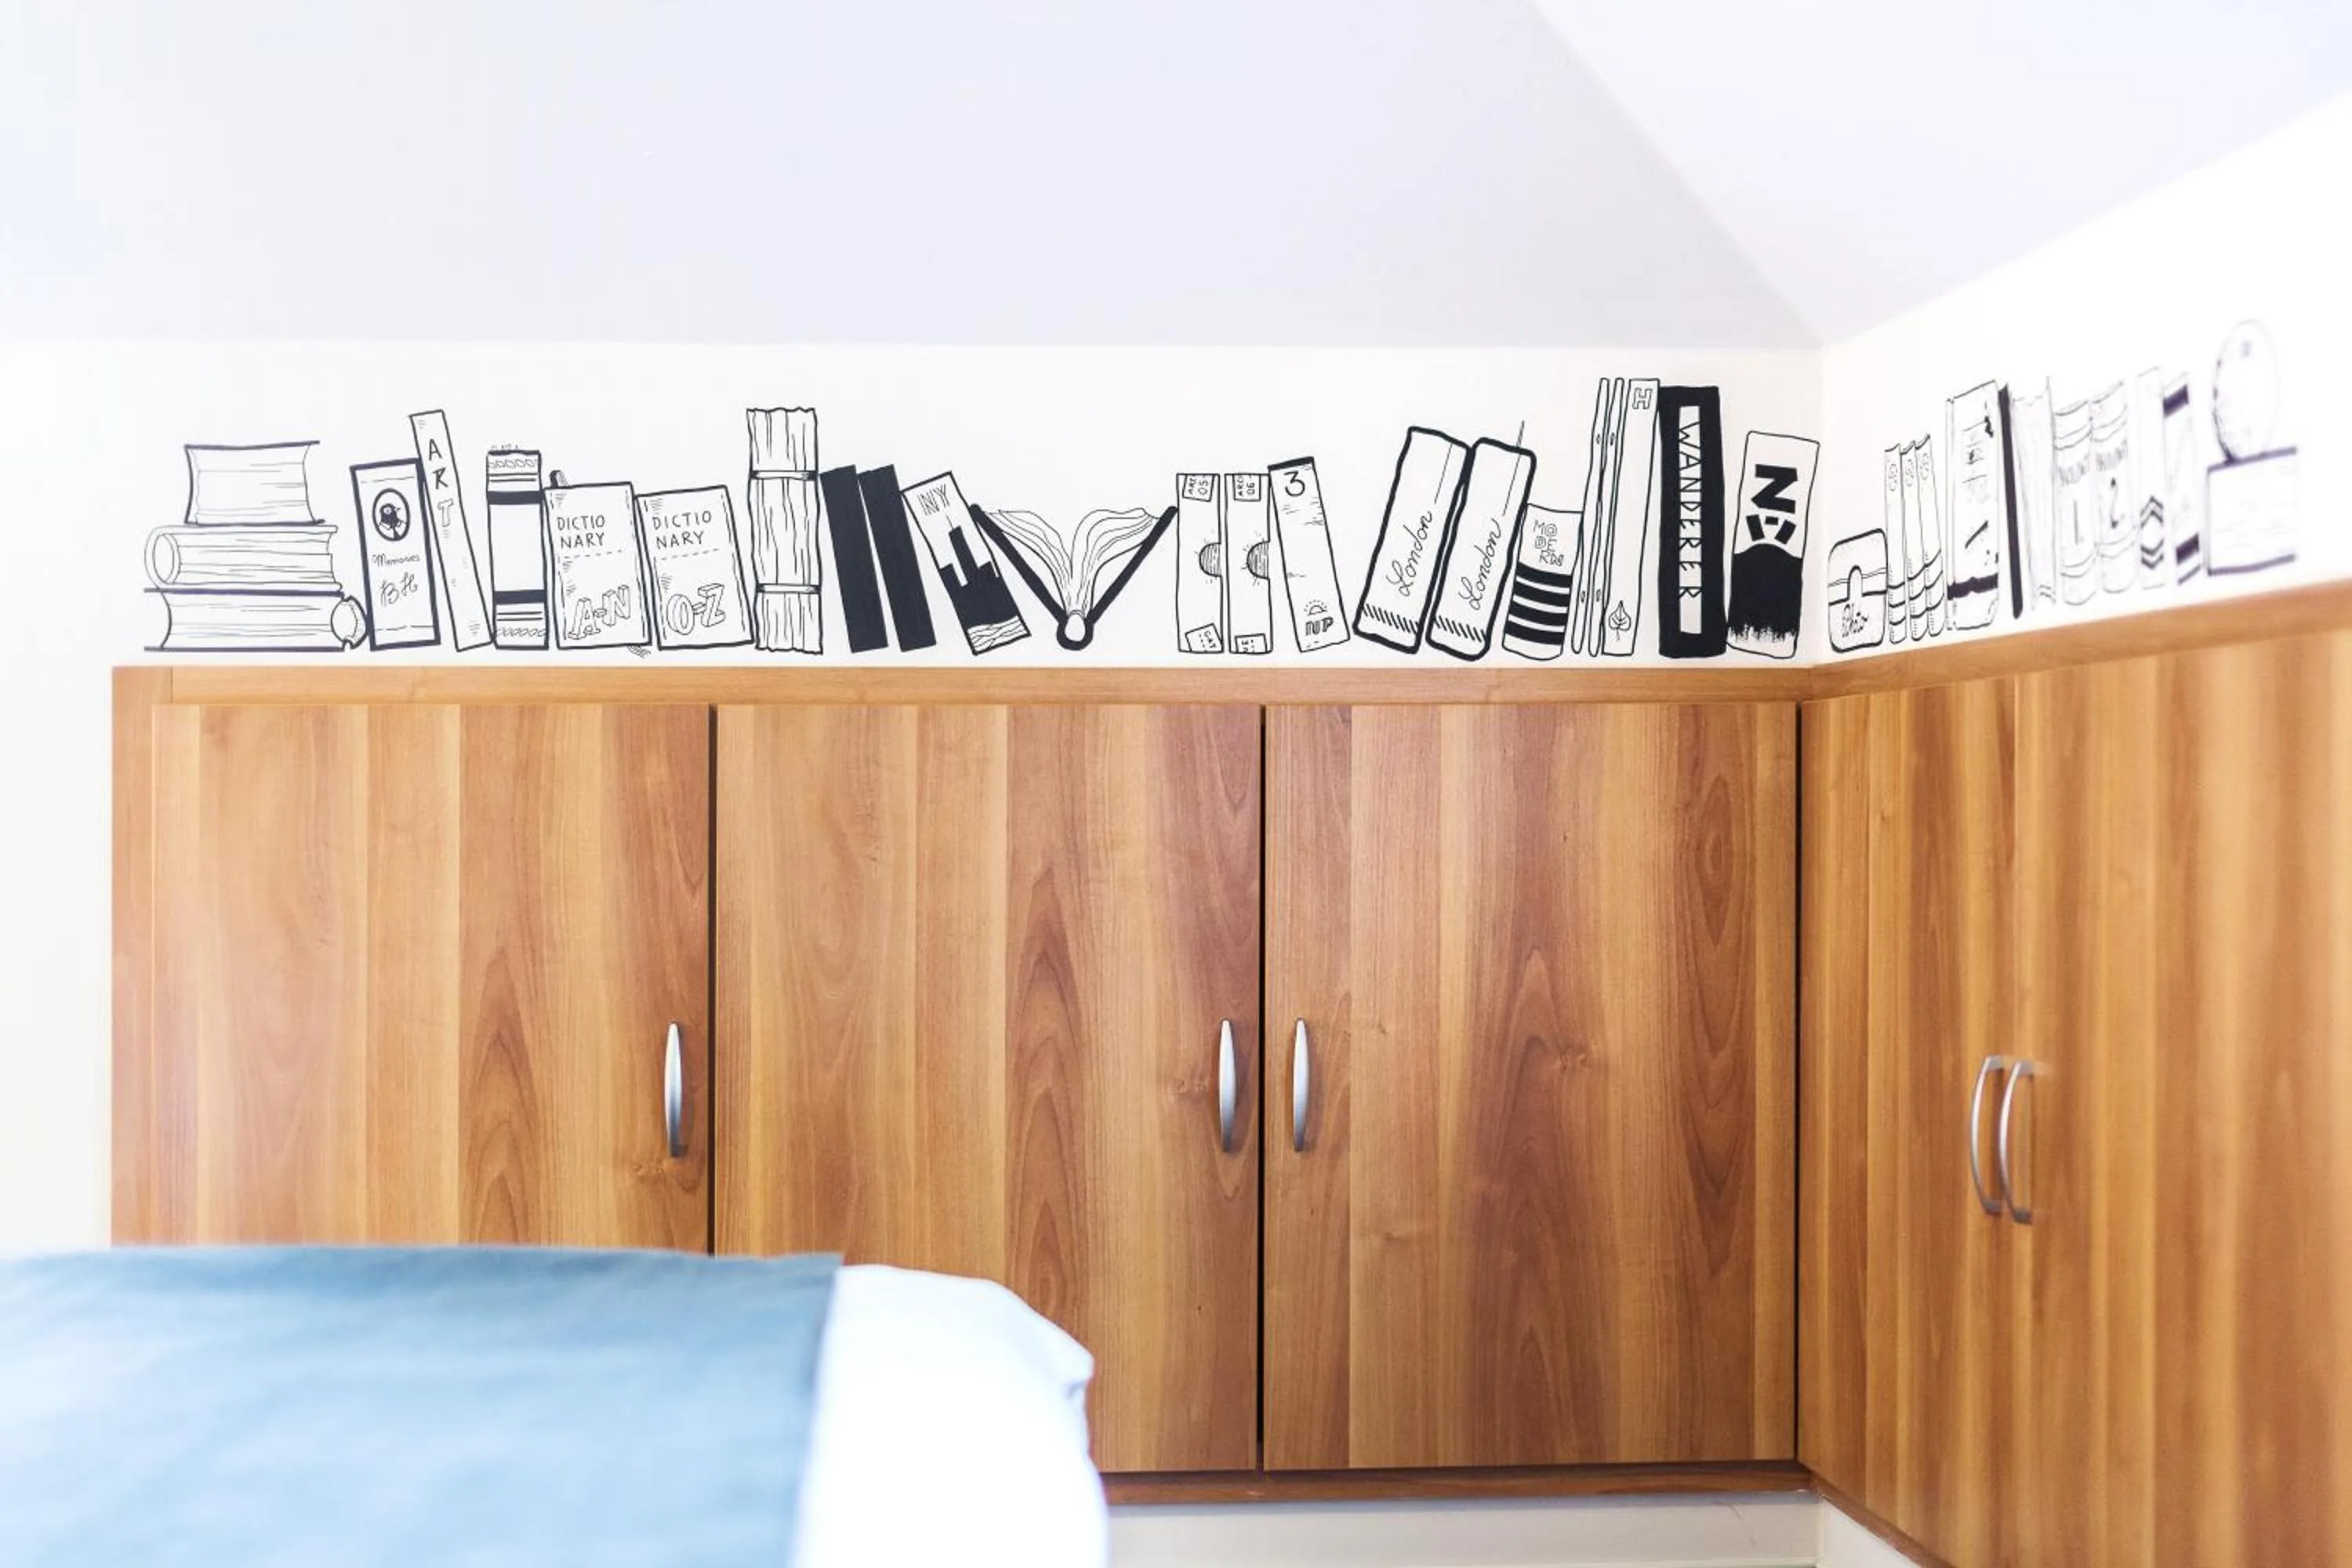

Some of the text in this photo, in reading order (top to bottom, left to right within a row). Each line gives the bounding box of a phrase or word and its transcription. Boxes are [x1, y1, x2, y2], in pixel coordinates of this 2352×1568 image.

[1632, 388, 1652, 409] H
[429, 438, 454, 528] ART
[1283, 470, 1305, 496] 3
[652, 510, 712, 530] DICTIO
[1678, 419, 1702, 599] WANDERER
[557, 514, 605, 531] DICTIO
[561, 532, 604, 549] NARY
[656, 531, 704, 549] NARY
[1386, 510, 1432, 597] London
[1457, 517, 1501, 611] London
